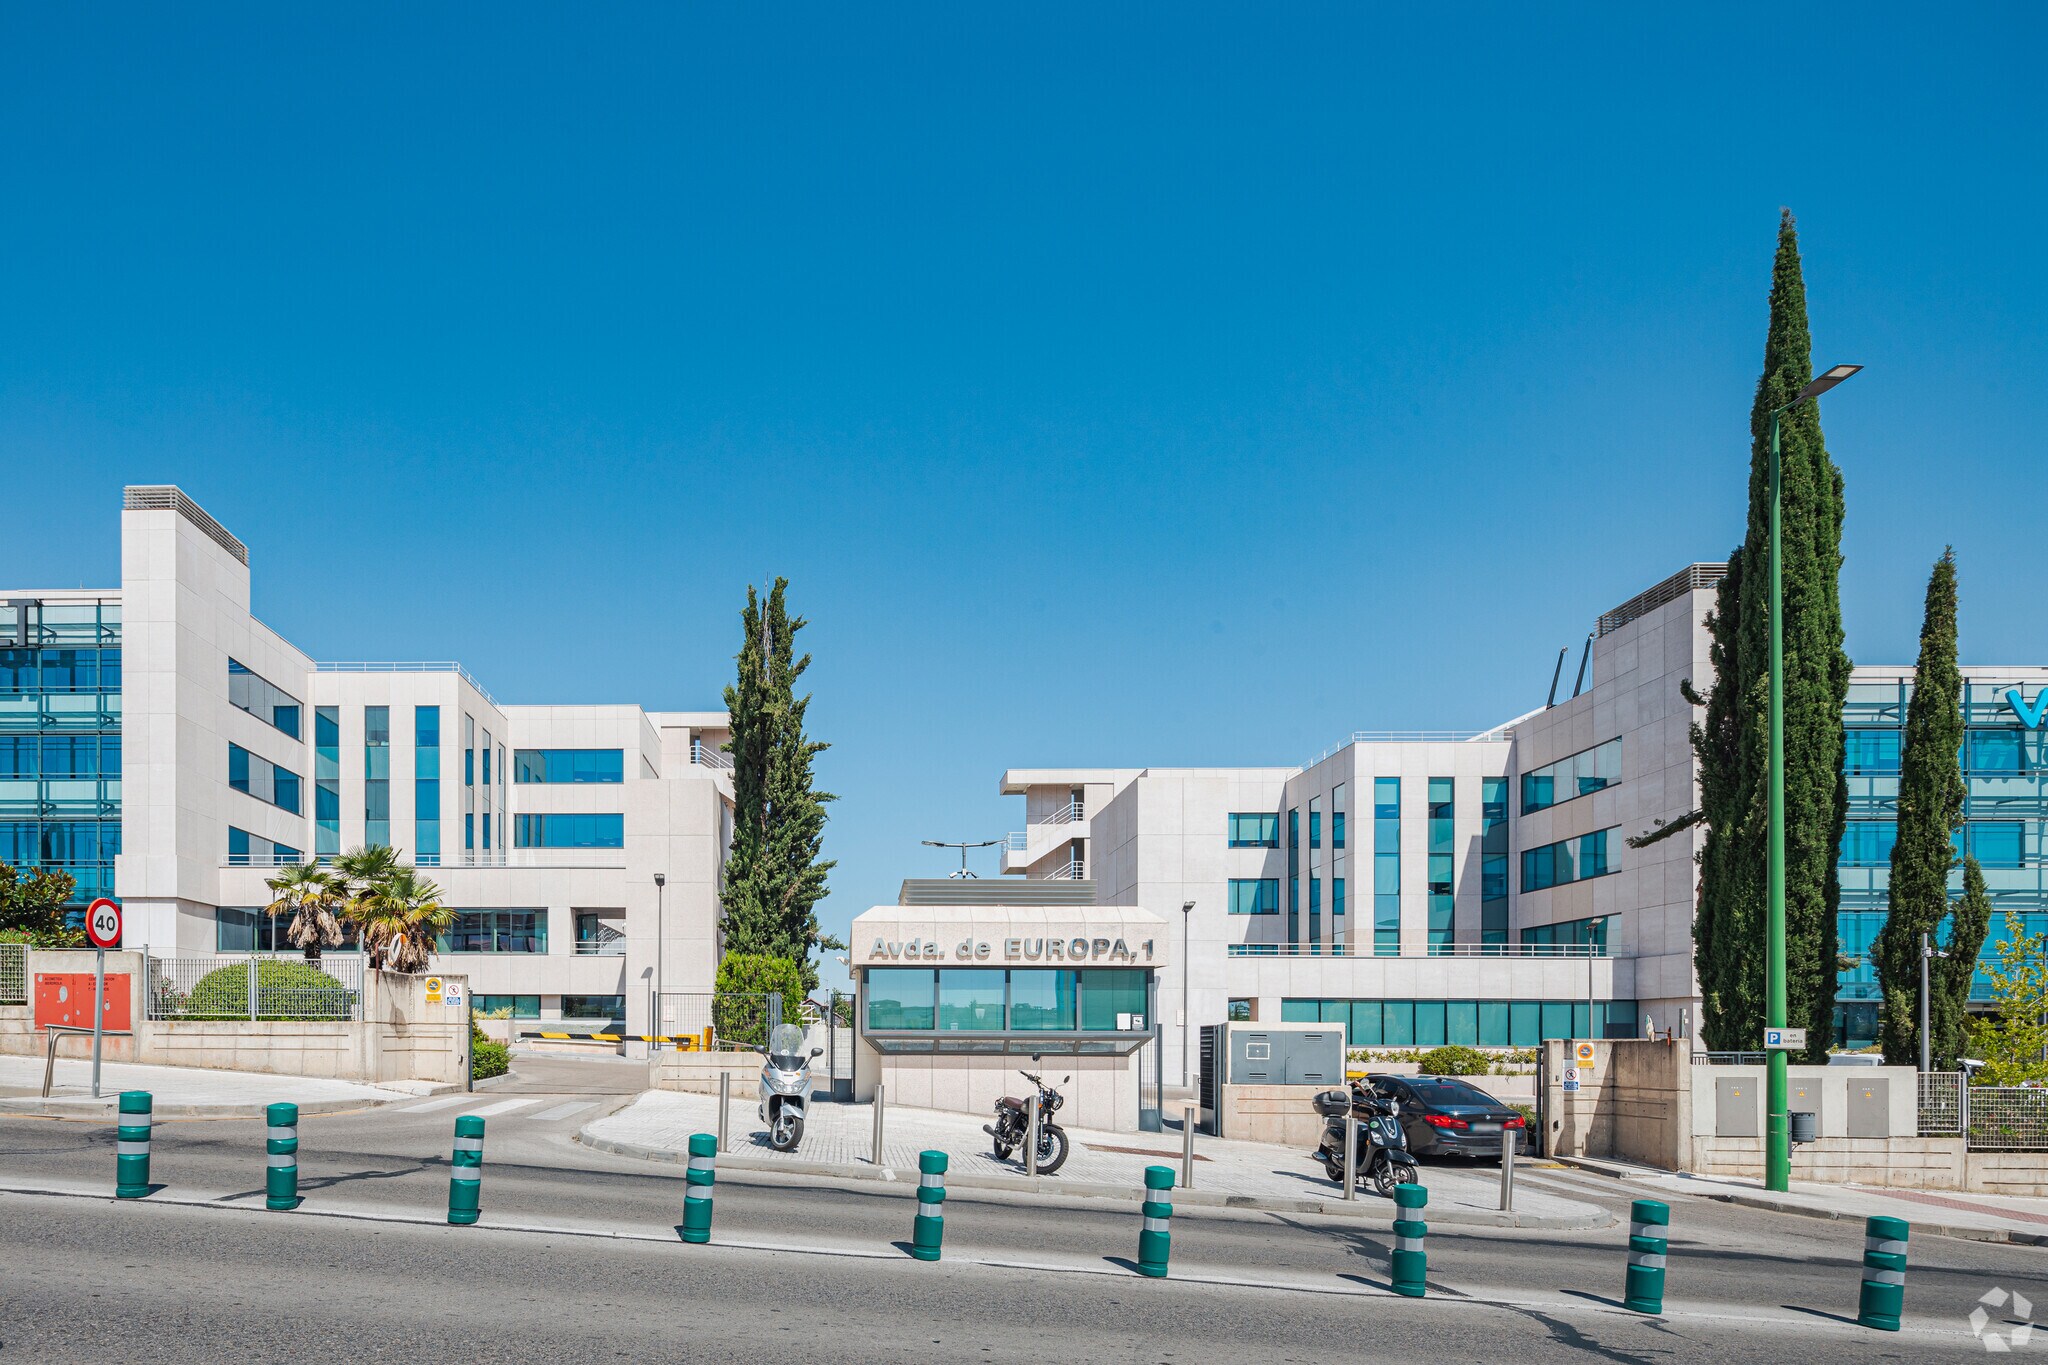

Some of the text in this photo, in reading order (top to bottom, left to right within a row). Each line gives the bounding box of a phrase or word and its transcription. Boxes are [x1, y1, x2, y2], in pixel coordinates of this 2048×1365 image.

[95, 914, 116, 932] 40
[868, 937, 946, 959] Avda.
[955, 937, 992, 959] de
[1770, 1033, 1779, 1043] P
